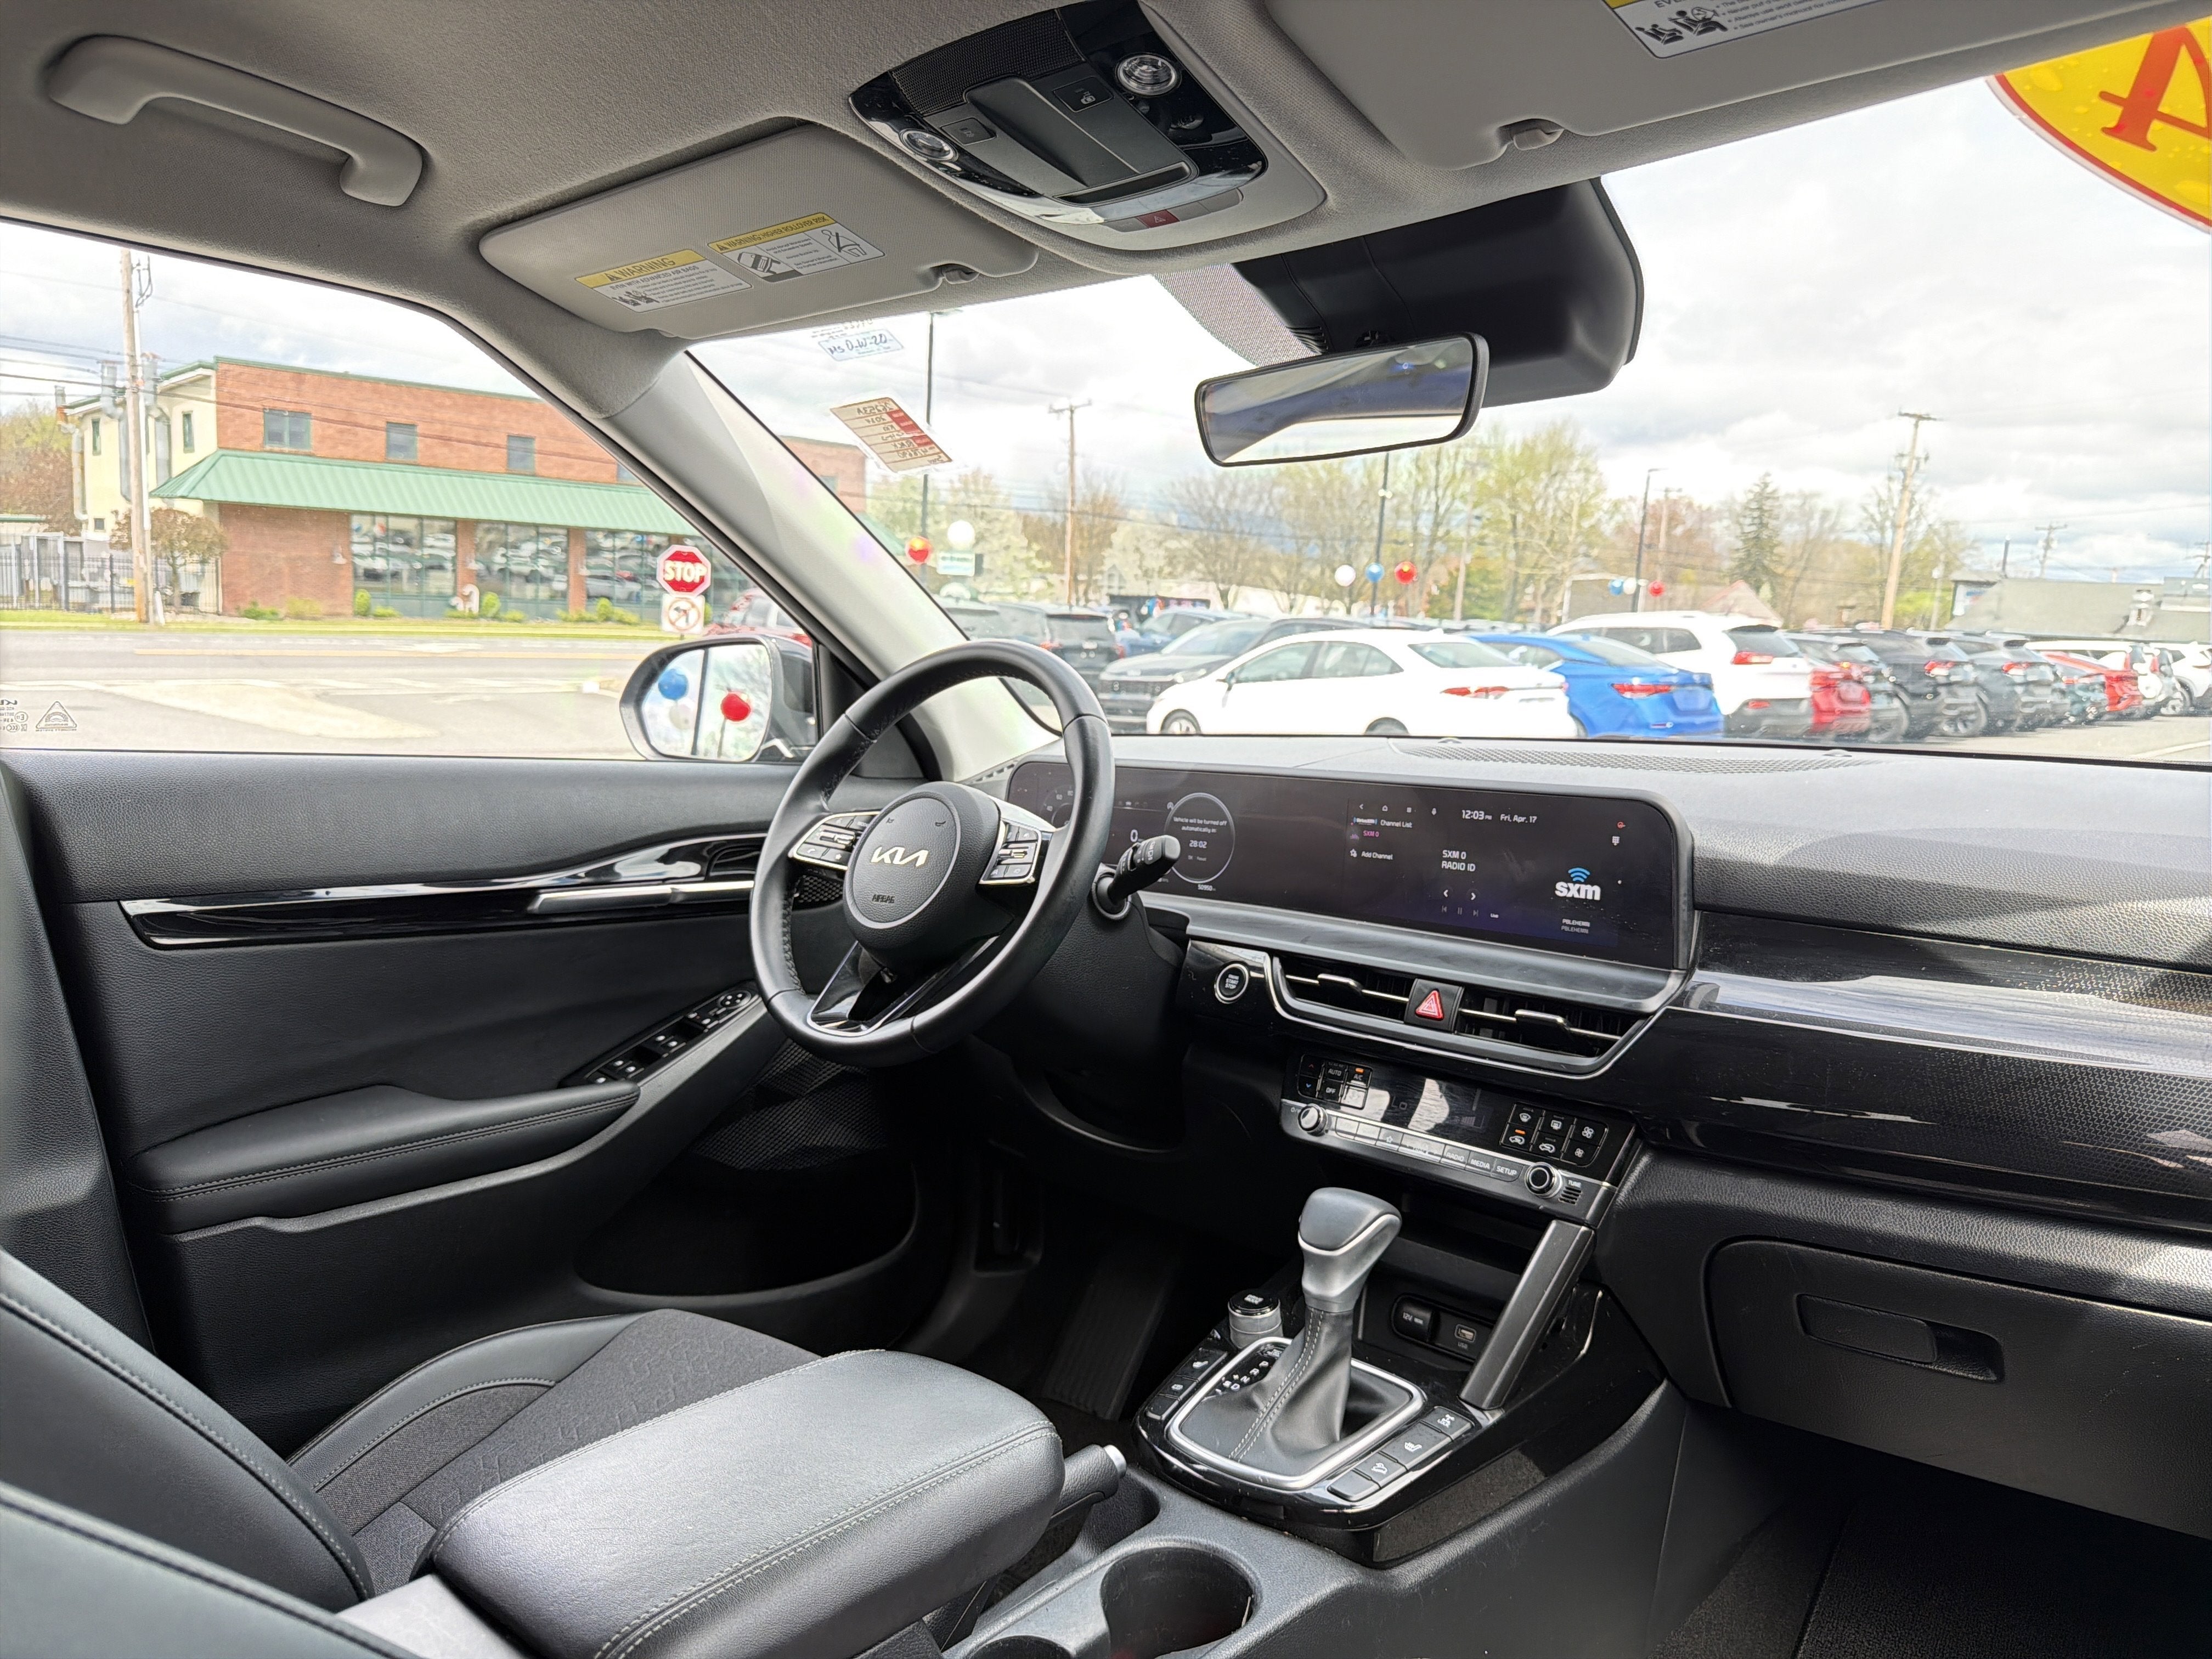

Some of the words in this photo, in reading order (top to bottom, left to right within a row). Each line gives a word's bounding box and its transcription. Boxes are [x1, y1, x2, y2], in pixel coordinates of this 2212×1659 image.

[761, 228, 783, 239] HIGHER
[783, 221, 813, 234] ROLLOVER
[812, 216, 828, 224] RISK
[615, 257, 676, 278] WARNING
[640, 272, 672, 283] ADVANCED
[680, 265, 699, 273] BAGS
[663, 560, 707, 583] STOP
[1462, 809, 1485, 820] 12:03
[1513, 815, 1528, 823] Apr.
[1131, 830, 1138, 842] 0
[1189, 840, 1207, 849] 28:02
[870, 845, 929, 867] KIA
[1372, 852, 1393, 860] Channel
[1442, 850, 1459, 859] SXM
[1441, 861, 1465, 871] RADIO
[1468, 863, 1476, 872] ID
[1555, 881, 1601, 901] sxm
[1328, 1068, 1342, 1076] AUTO
[1446, 1152, 1465, 1163] RADIO
[1470, 1159, 1491, 1170] MEDIA
[1497, 1166, 1517, 1176] SETUP
[1568, 1180, 1582, 1188] TUNE
[1402, 1312, 1413, 1321] 12V
[1231, 1383, 1240, 1391] D
